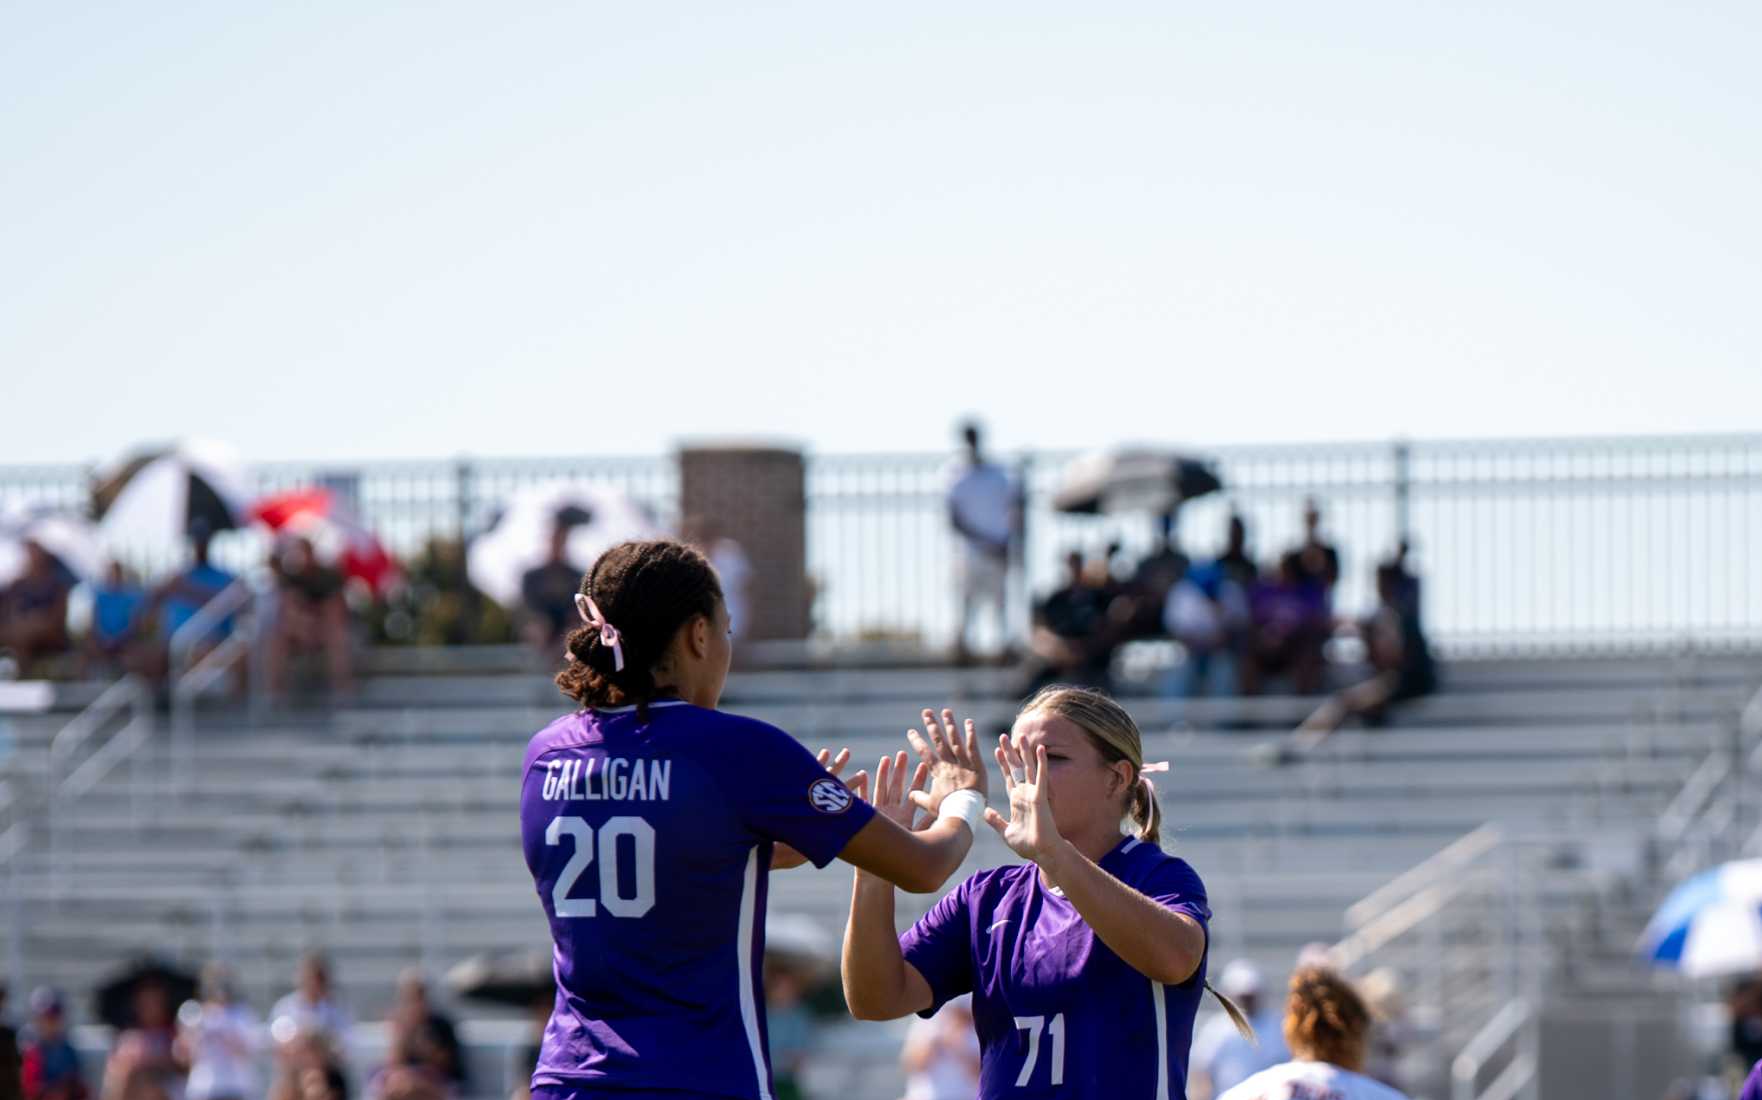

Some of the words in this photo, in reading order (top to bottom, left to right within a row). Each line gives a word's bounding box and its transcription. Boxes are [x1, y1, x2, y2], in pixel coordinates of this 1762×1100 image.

[542, 758, 671, 801] GALLIGAN
[545, 816, 656, 918] 20
[1013, 1013, 1065, 1087] 71
